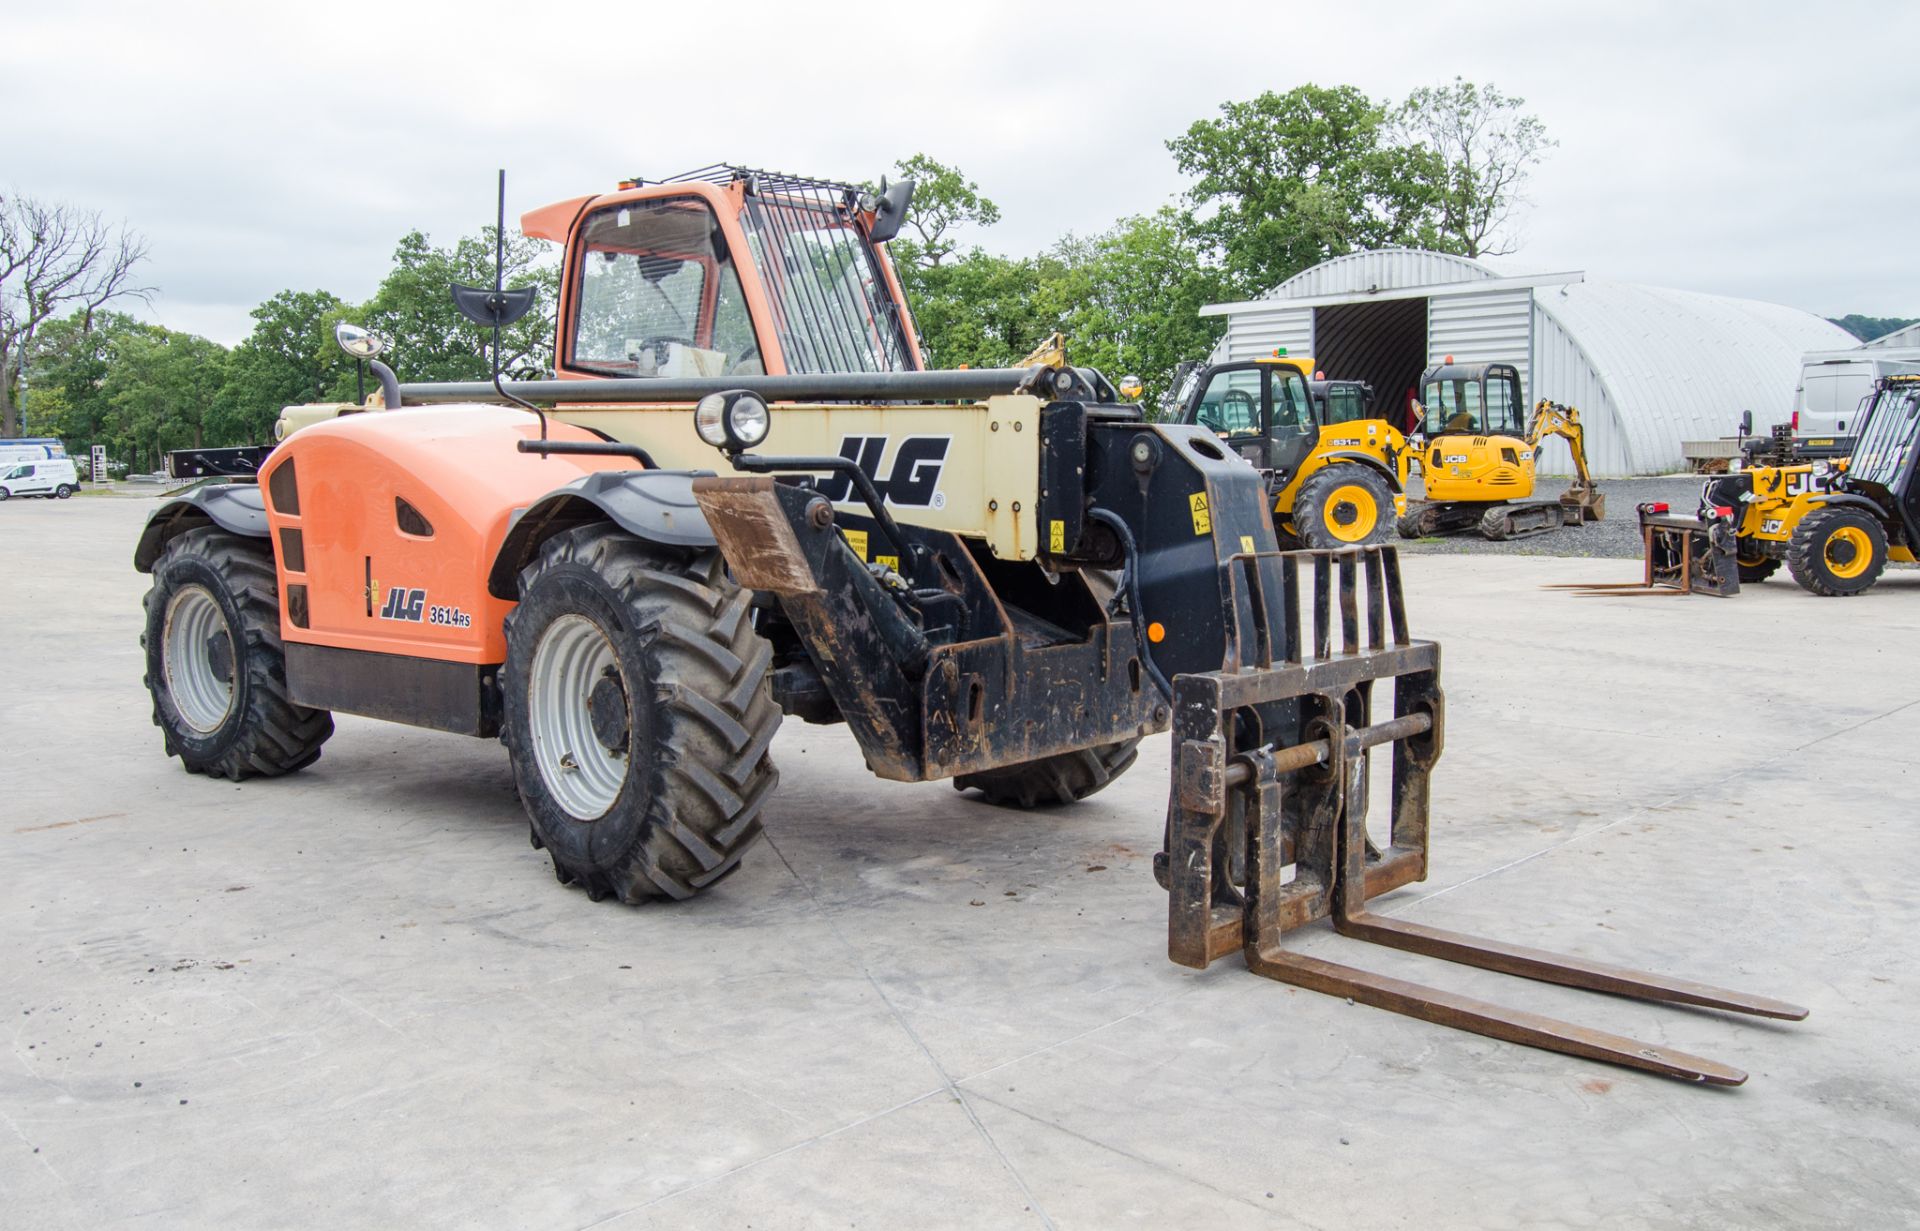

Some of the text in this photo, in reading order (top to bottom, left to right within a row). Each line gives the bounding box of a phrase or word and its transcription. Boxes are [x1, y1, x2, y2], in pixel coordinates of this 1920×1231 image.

[816, 437, 950, 506] JLG
[1445, 455, 1466, 463] JCB
[381, 588, 471, 627] JLG 3614RS
